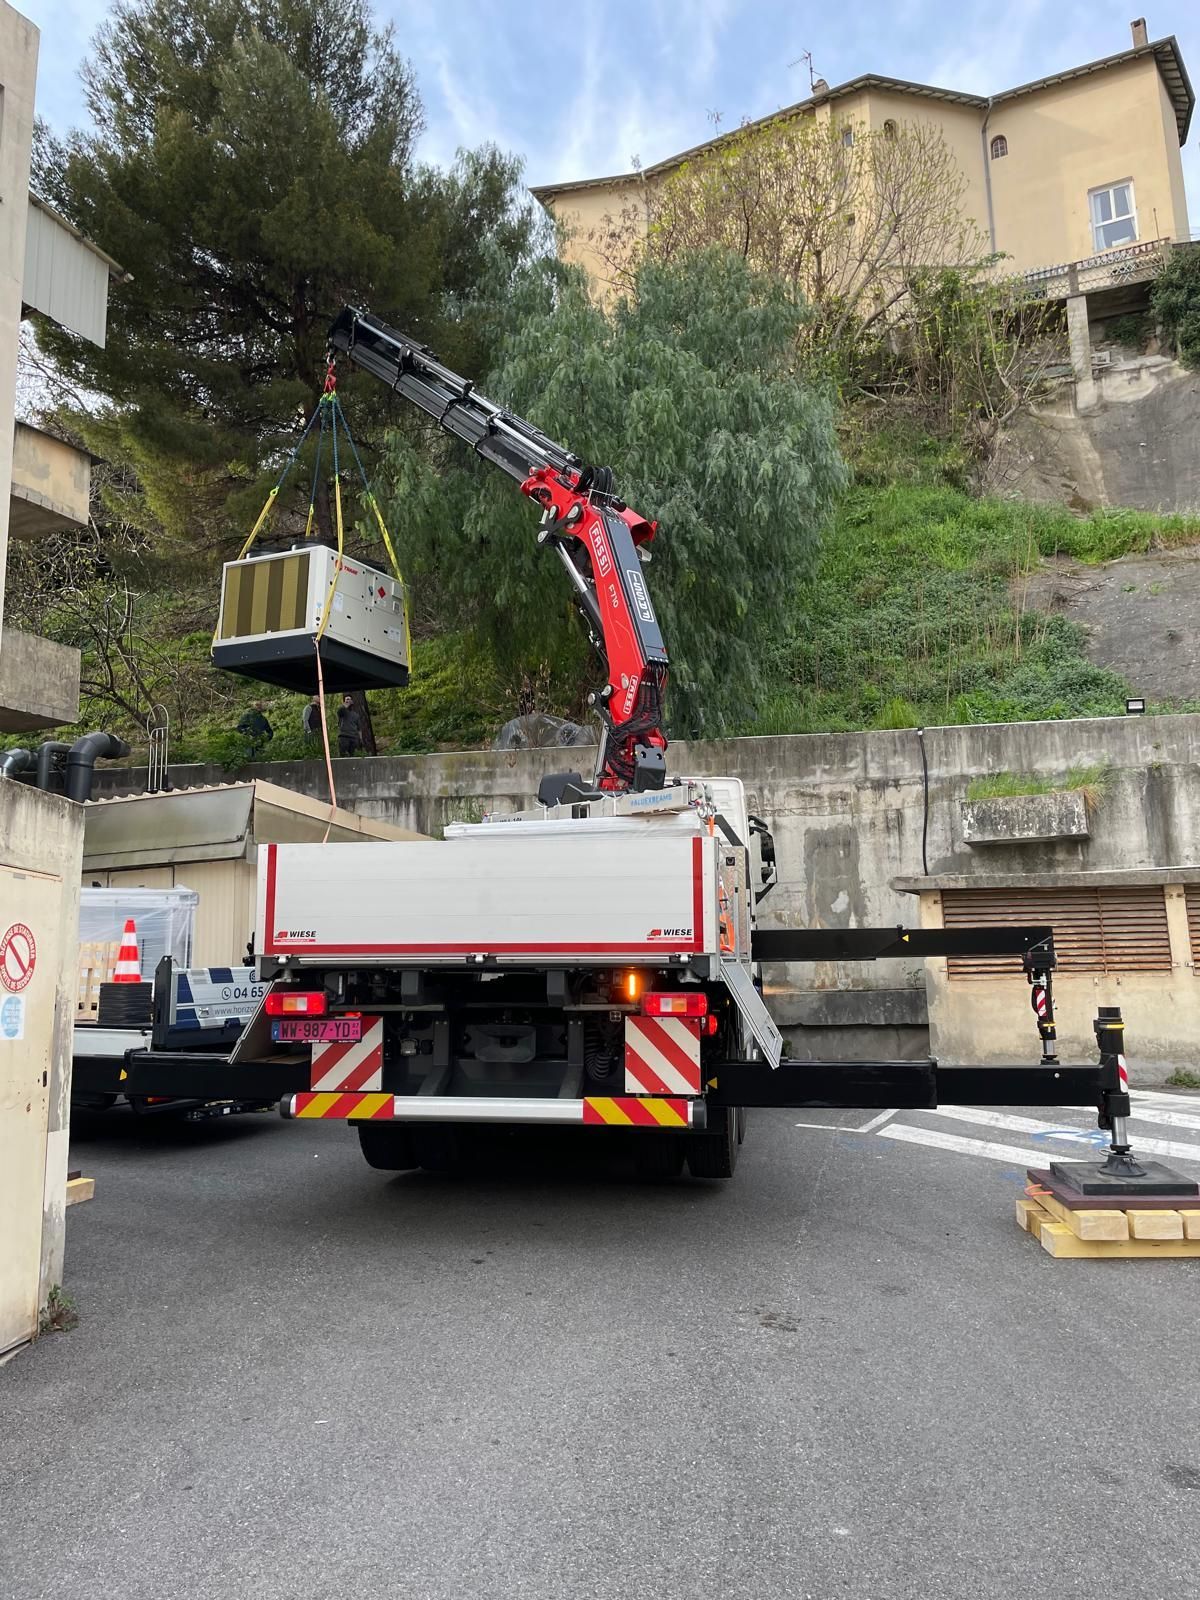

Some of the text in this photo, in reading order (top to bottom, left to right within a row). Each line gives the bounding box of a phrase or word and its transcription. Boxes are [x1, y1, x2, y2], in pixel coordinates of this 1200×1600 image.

[591, 527, 609, 571] FASSI
[608, 583, 619, 608] F710
[632, 573, 651, 619] FASSI
[624, 678, 636, 711] FASSI
[289, 930, 317, 938] WIESE
[663, 928, 693, 936] WIESE
[233, 986, 264, 999] 04 65
[281, 1022, 350, 1038] WW-987-YD
